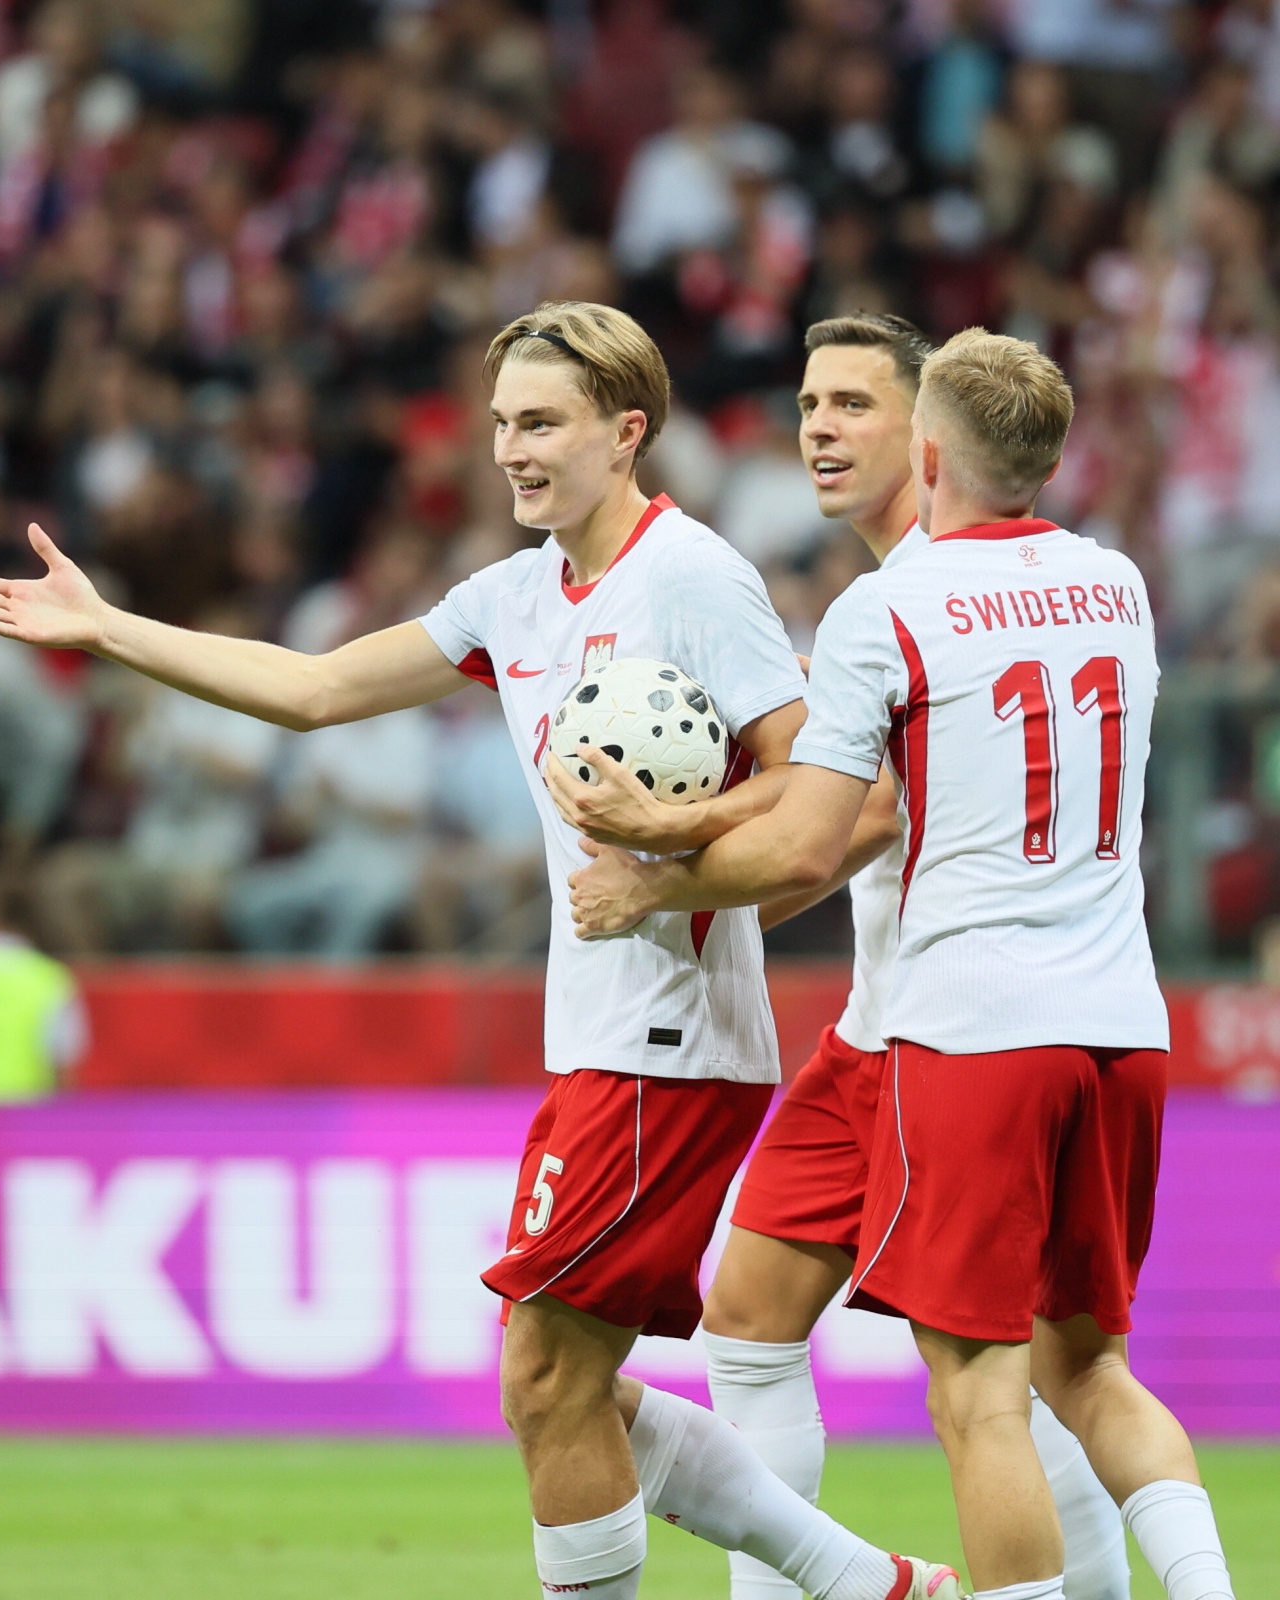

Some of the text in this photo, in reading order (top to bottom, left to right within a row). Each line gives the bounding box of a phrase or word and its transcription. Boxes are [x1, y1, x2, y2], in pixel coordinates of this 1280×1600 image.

[945, 584, 1141, 635] ŚWIDERSKI
[992, 656, 1128, 864] 11
[525, 1152, 564, 1236] 5
